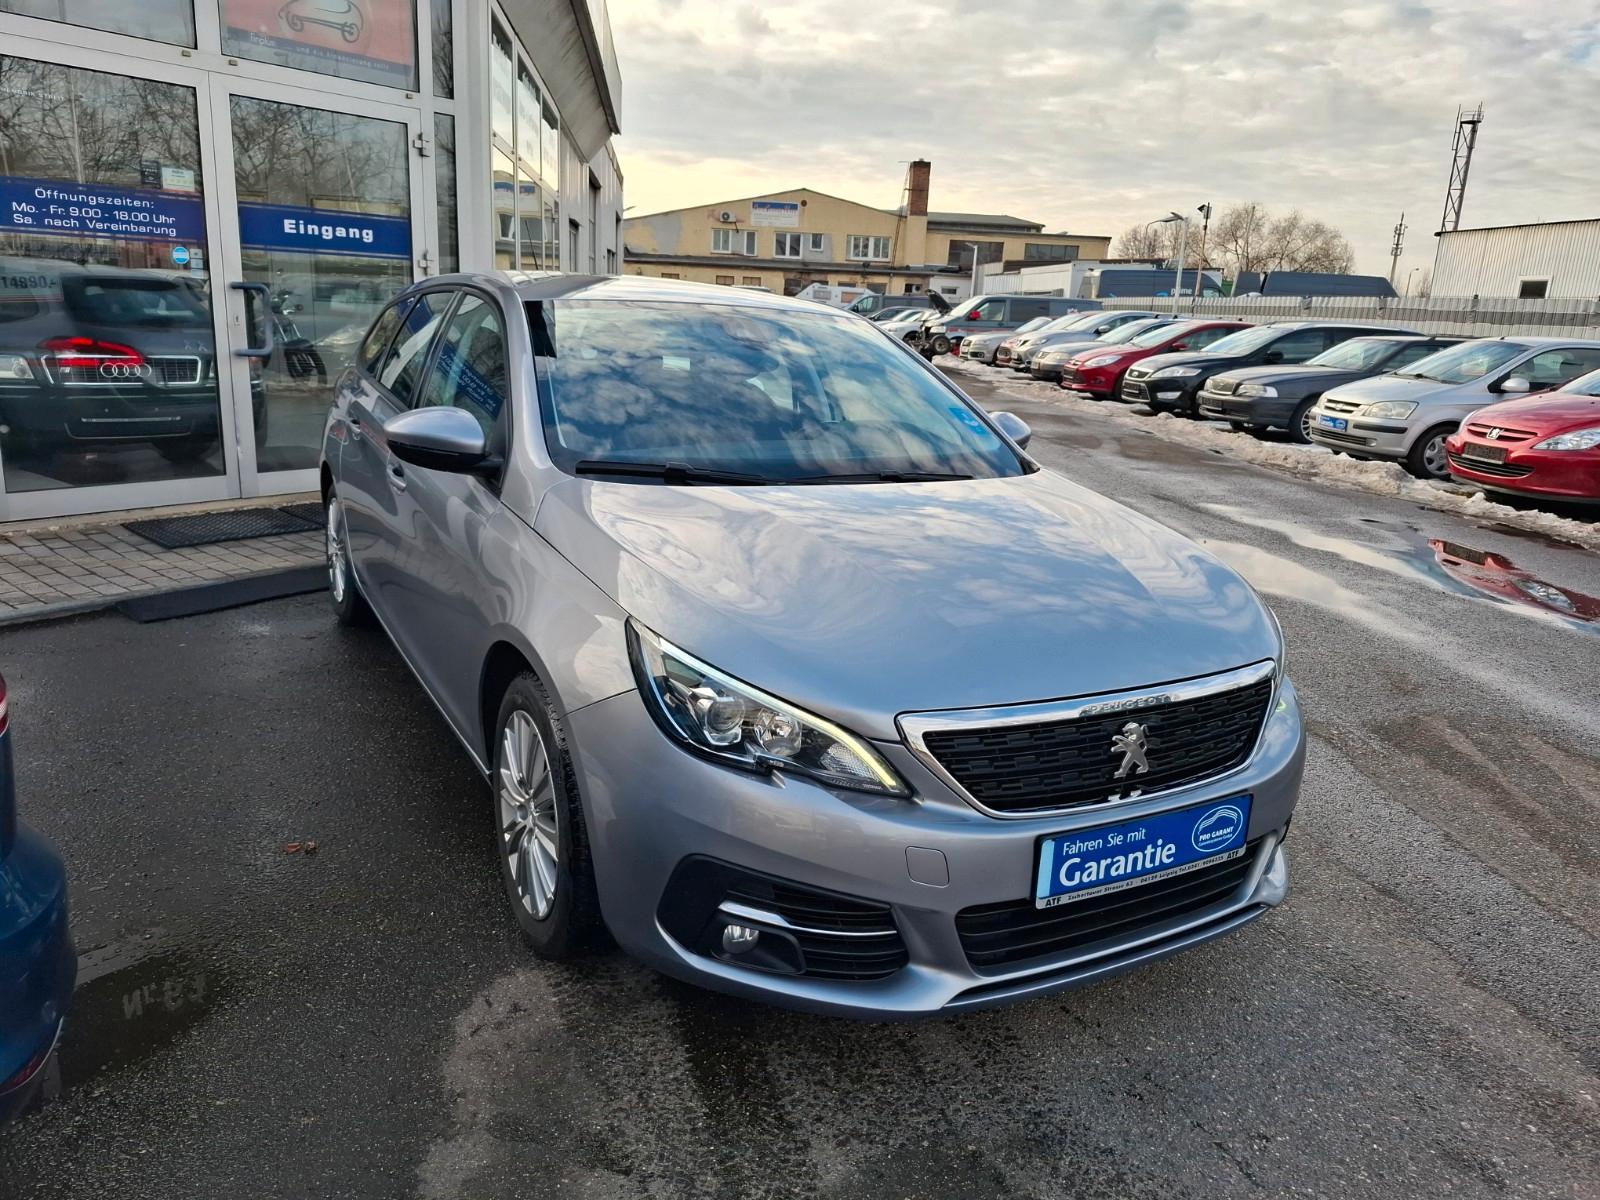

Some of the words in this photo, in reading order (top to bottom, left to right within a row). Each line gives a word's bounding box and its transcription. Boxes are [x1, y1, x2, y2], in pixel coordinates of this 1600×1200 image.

[34, 187, 155, 209] Öffnungszeiten:
[12, 202, 39, 213] Mo.
[49, 205, 66, 216] Fr.
[69, 207, 101, 219] 9.00
[113, 210, 150, 222] 18.00
[152, 213, 176, 225] Uhr
[13, 214, 37, 225] Sa.
[44, 217, 79, 228] nach
[86, 219, 177, 237] Vereinbarung
[283, 218, 374, 243] Eingang
[1090, 695, 1168, 714] PEUGEOT
[1062, 840, 1102, 856] Fahren
[1107, 833, 1123, 847] Sie
[1127, 828, 1146, 843] mit
[1199, 833, 1211, 841] PRO
[1211, 826, 1234, 838] GARANT
[1059, 838, 1176, 887] Garantie
[1045, 896, 1062, 908] ATF
[1159, 870, 1178, 878] Leipzig
[1227, 849, 1240, 860] ATF
